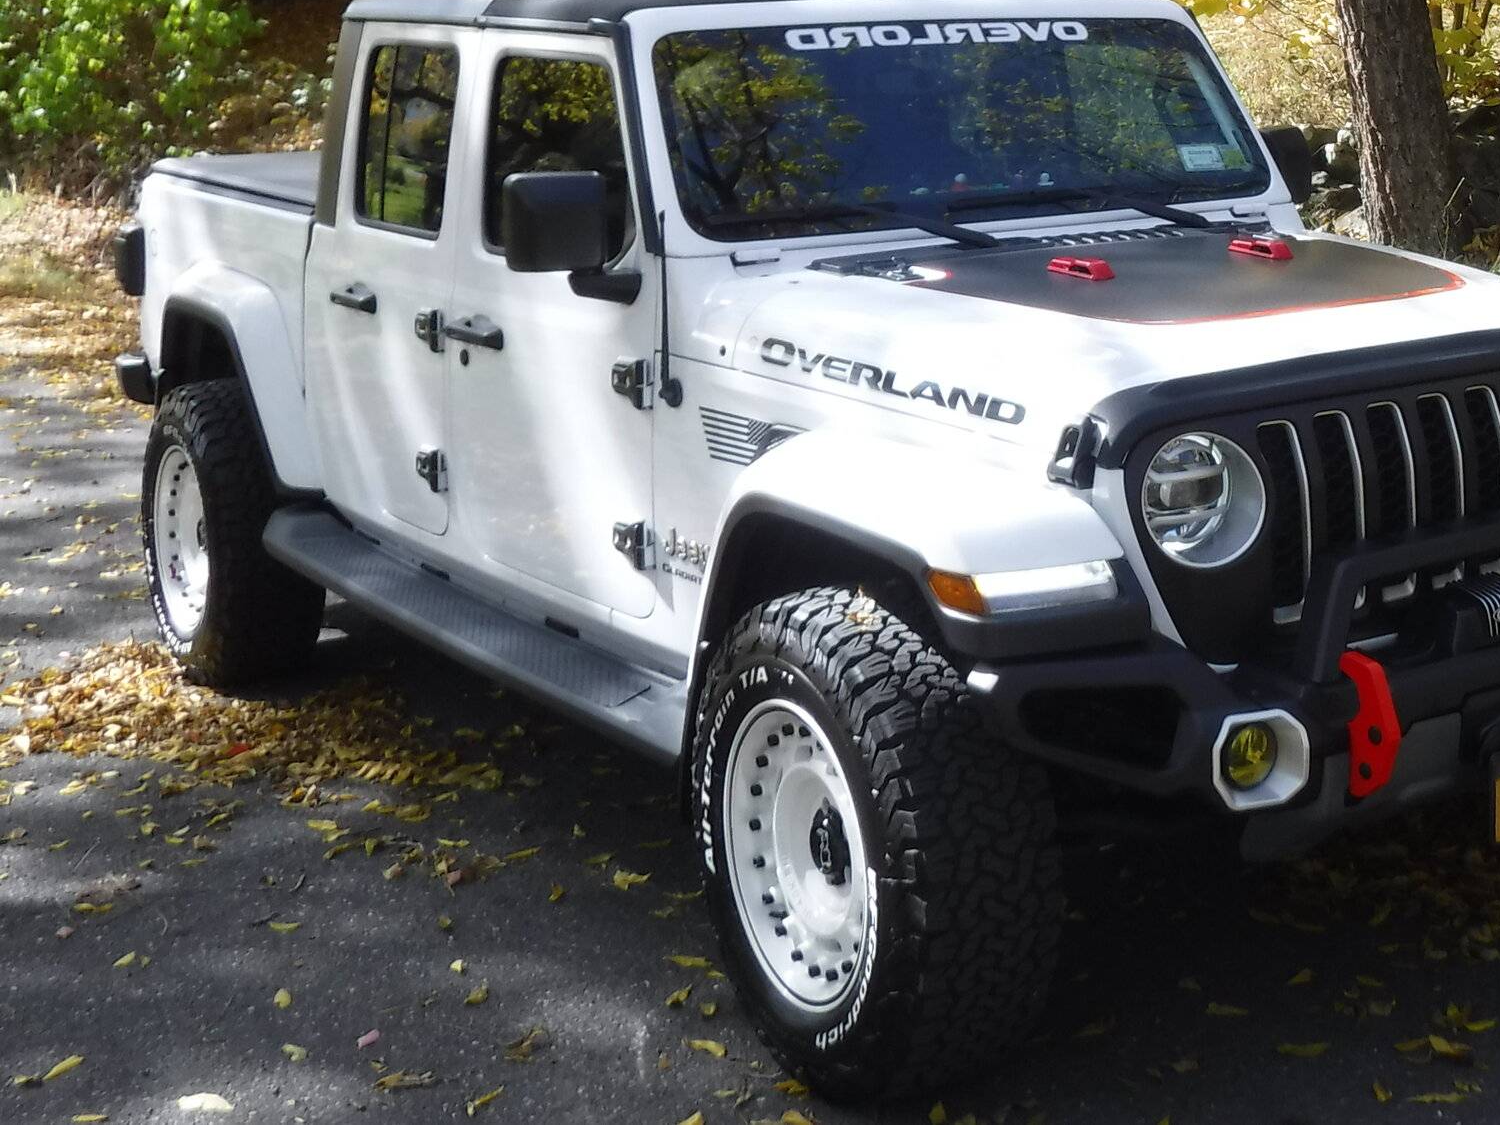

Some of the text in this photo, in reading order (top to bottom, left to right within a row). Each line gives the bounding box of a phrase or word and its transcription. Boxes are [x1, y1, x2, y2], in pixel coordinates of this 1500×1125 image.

[760, 337, 1026, 425] OVERLAND
[702, 666, 769, 874] All-Terrain T/A
[815, 866, 878, 1050] BFGoodrich
